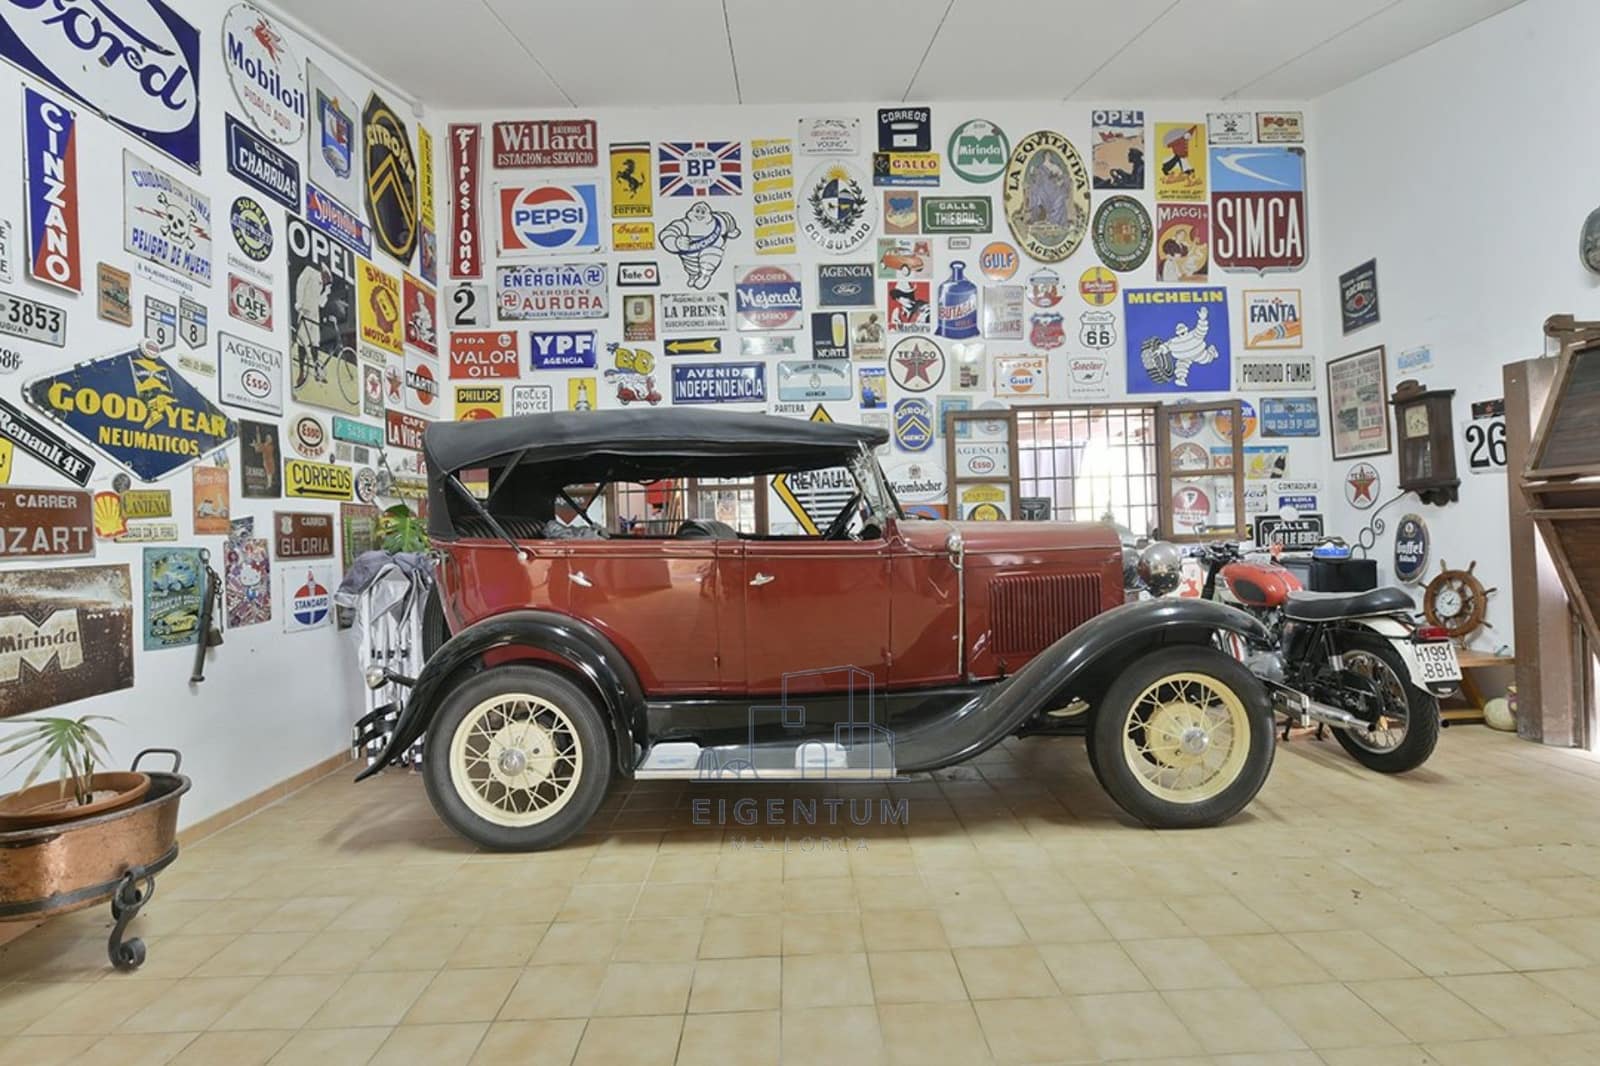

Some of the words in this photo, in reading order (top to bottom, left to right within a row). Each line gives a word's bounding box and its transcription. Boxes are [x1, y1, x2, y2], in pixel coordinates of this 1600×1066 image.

[0, 0, 188, 110] ord
[228, 31, 304, 118] Mobiloil
[881, 110, 928, 123] CORREOS
[1093, 111, 1143, 124] OPEL
[498, 124, 593, 151] Willard
[498, 153, 542, 165] ESTACION
[552, 153, 593, 164] SERVICIO
[687, 159, 716, 176] BP
[892, 159, 937, 169] GALLO
[132, 169, 172, 193] CUIDADO
[239, 147, 297, 199] CHARRUAS
[40, 102, 70, 282] CINZANO
[456, 128, 475, 274] Firestone
[515, 208, 584, 226] PEPSI
[1157, 207, 1201, 227] MAGGI
[805, 223, 871, 250] CONSULADO
[1217, 198, 1304, 258] SIMCA
[132, 228, 168, 260] PELIGRO
[170, 246, 182, 266] DE
[288, 220, 355, 285] OPEL
[1027, 239, 1076, 257] AGENCIA
[983, 254, 1015, 269] GULF
[504, 274, 583, 287] ENERGINA
[820, 266, 873, 278] AGENCIA
[366, 266, 399, 297] SHELL
[236, 294, 266, 317] CAFE
[522, 296, 603, 310] AURORA
[737, 286, 802, 309] Mejoral
[1128, 291, 1223, 304] MICHELIN
[9, 299, 60, 333] 3853
[453, 289, 476, 325] 2
[664, 306, 678, 318] LA
[682, 305, 726, 318] PRENSA
[1250, 303, 1298, 323] FANTA
[157, 328, 165, 344] 9
[190, 325, 198, 342] 8
[1086, 331, 1110, 345] 66
[535, 335, 593, 354] YPF
[817, 349, 848, 358] NORTE
[225, 341, 281, 369] AGENCIA
[451, 351, 517, 365] VALOR
[543, 357, 584, 365] AGENCIA
[468, 366, 500, 377] OIL
[1010, 376, 1034, 385] Gulf
[1243, 364, 1283, 382] PROHIBIDO
[1286, 363, 1311, 382] FUMAR
[458, 390, 499, 401] PHILIPS
[517, 391, 548, 400] ROLLS
[675, 379, 763, 398] INDEPENDENCIA
[516, 401, 548, 410] ROYCE
[774, 403, 805, 413] PARTERA
[99, 426, 199, 456] NEUMATICOS
[388, 421, 401, 445] LA
[401, 428, 423, 450] VIRG
[0, 413, 64, 463] Renault
[63, 455, 85, 478] 4F
[957, 446, 1008, 455] AGENCIA
[1465, 422, 1507, 469] 26
[972, 460, 992, 469] Esso
[293, 463, 350, 490] CORREOS
[790, 470, 854, 490] RENAUL
[891, 480, 942, 494] Krombacher
[16, 494, 77, 509] CARRER
[301, 516, 327, 526] CARRER
[0, 527, 88, 553] ZART
[281, 538, 329, 555] GLORIA
[294, 597, 328, 610] STANDARD
[0, 629, 77, 653] Mirinda
